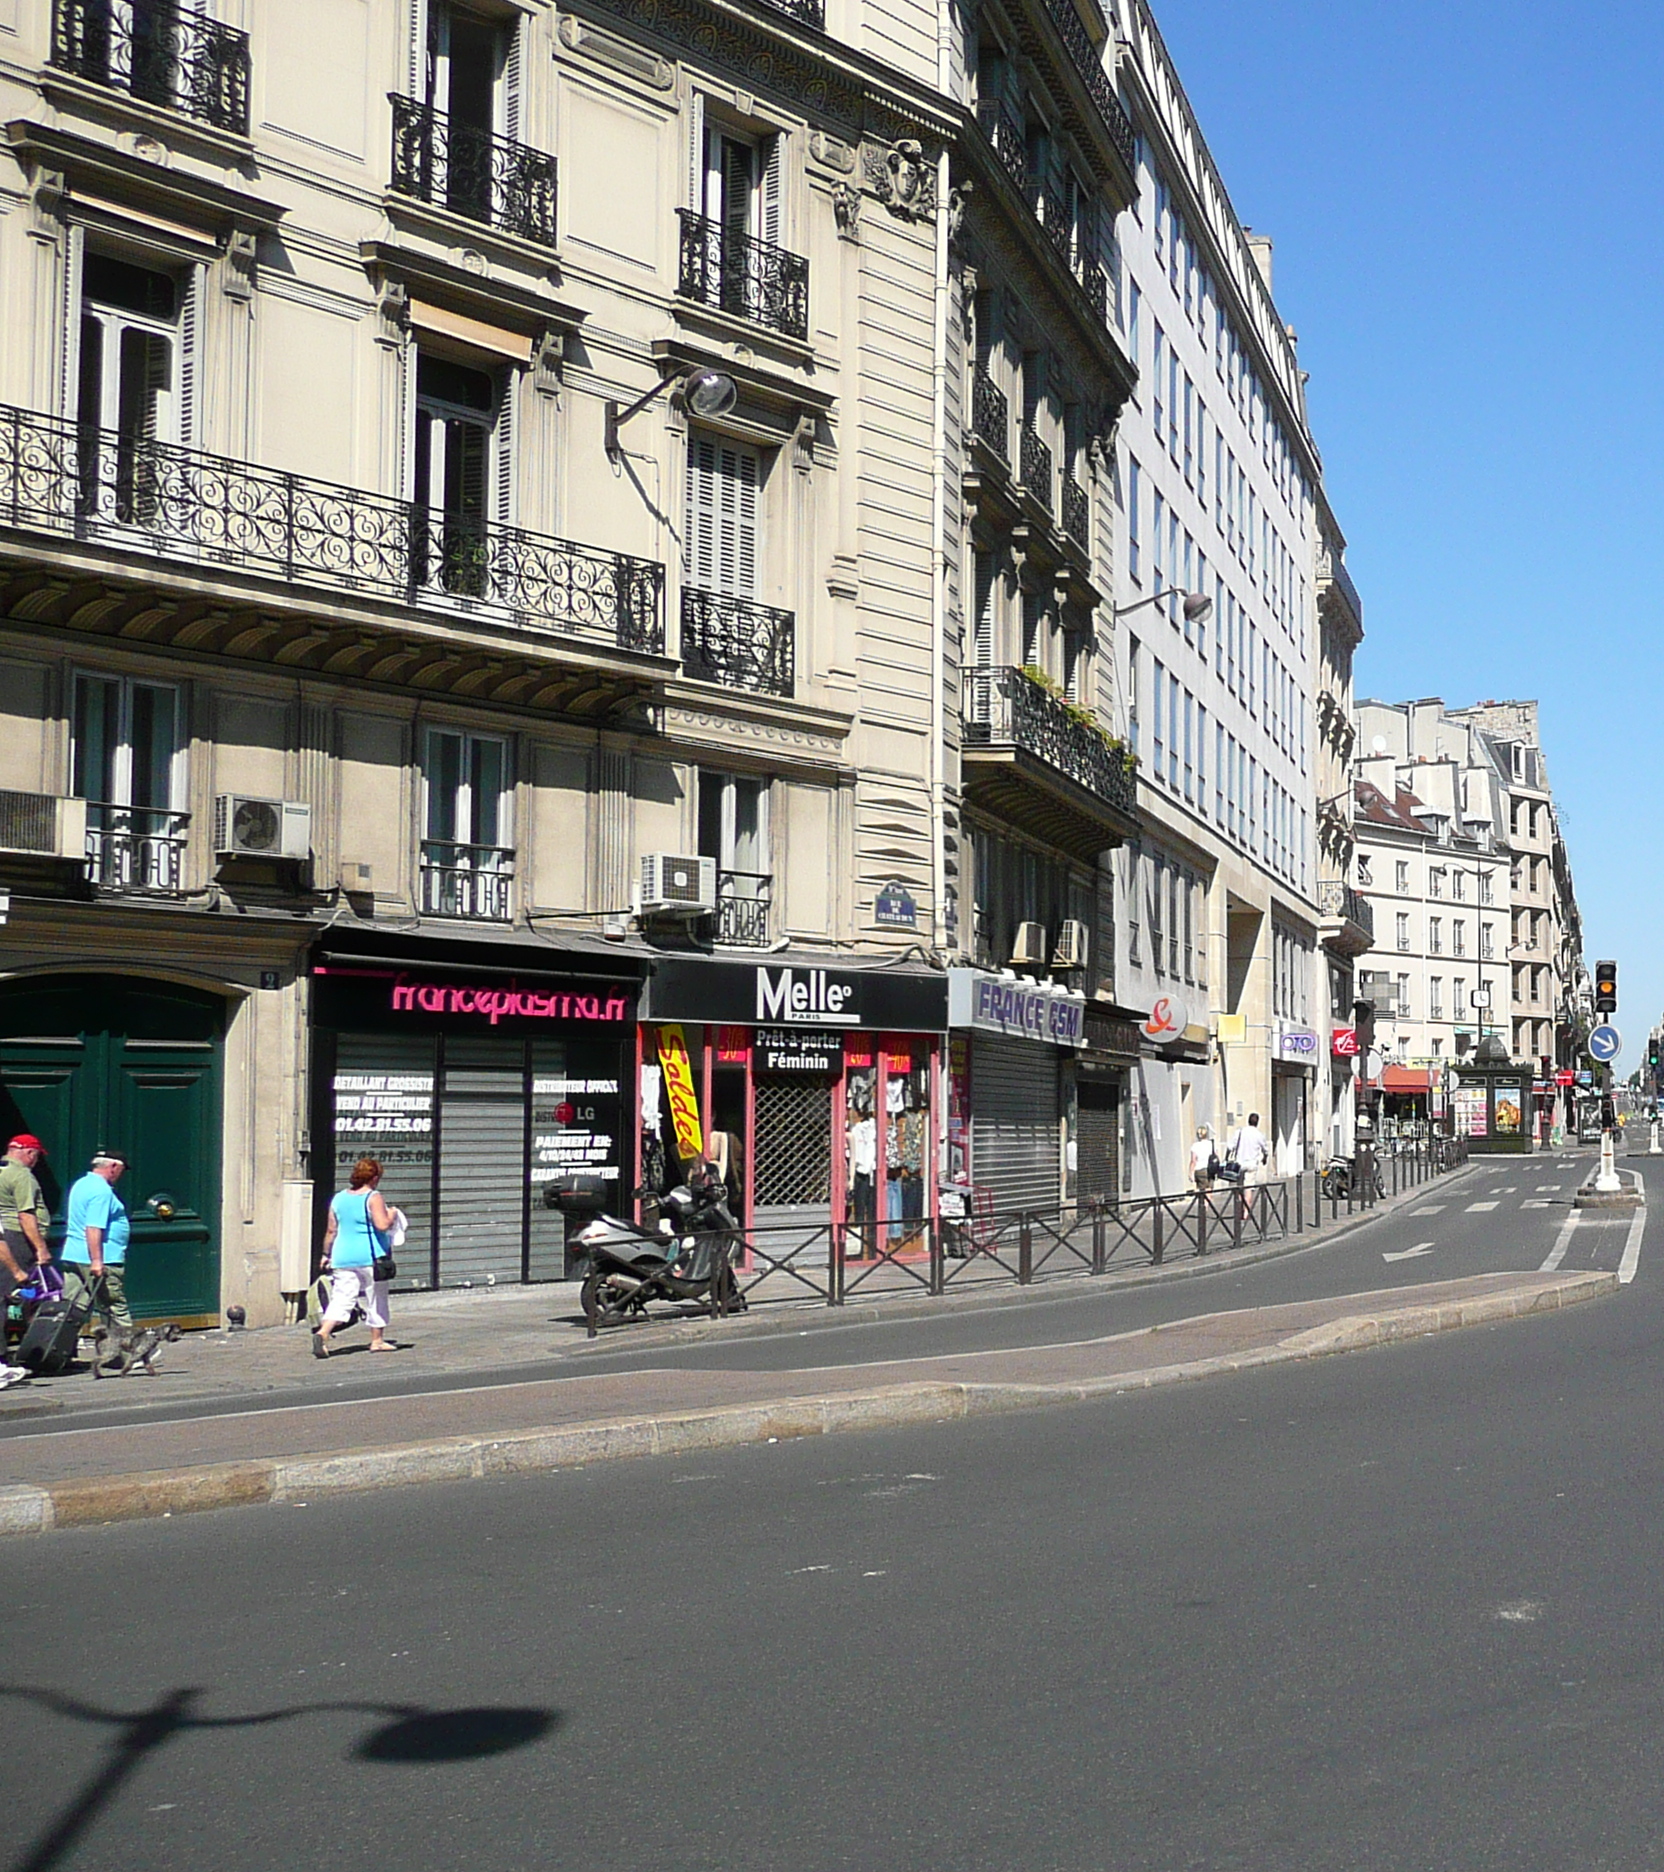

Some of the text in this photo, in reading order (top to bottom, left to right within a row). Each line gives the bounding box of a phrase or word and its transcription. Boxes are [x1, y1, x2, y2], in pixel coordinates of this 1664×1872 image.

[266, 973, 275, 989] 2
[791, 1012, 822, 1021] PARIS
[979, 981, 1045, 1032] FRANCE
[1049, 1000, 1080, 1038] GSM
[757, 1029, 842, 1052] Prêt-à-porter
[767, 1051, 829, 1071] Féminin
[658, 1030, 700, 1158] Soldes
[375, 1096, 431, 1110] PARTICULIER
[577, 1107, 596, 1121] LG
[335, 1117, 432, 1132] 01.42.81.55.06
[535, 1135, 593, 1148] PAIEMENT
